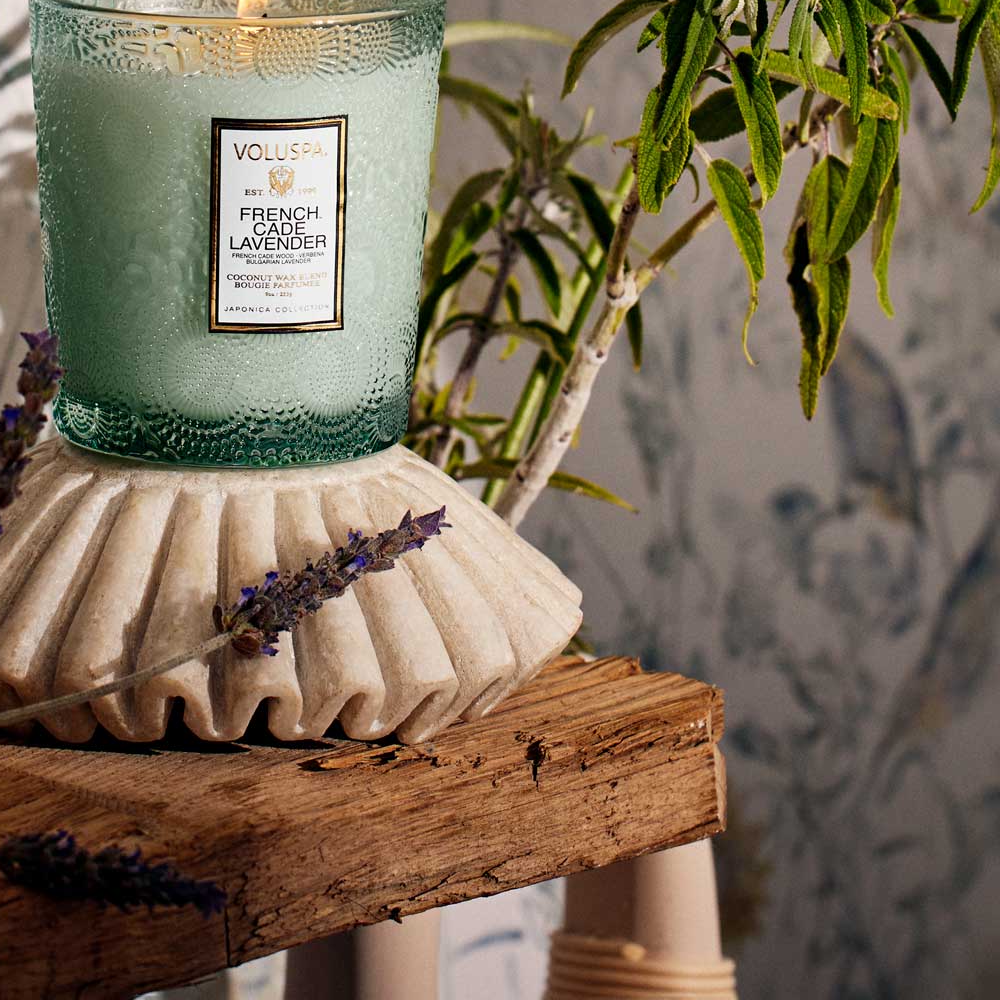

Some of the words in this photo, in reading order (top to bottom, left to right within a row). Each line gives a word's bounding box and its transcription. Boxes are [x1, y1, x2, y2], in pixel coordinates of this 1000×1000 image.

[240, 206, 319, 222] FRENCH
[253, 222, 306, 236] CADE
[229, 234, 327, 251] LAVENDER
[226, 273, 273, 282] COCONUT
[275, 273, 297, 281] WAX
[234, 281, 271, 289] BOUGIE
